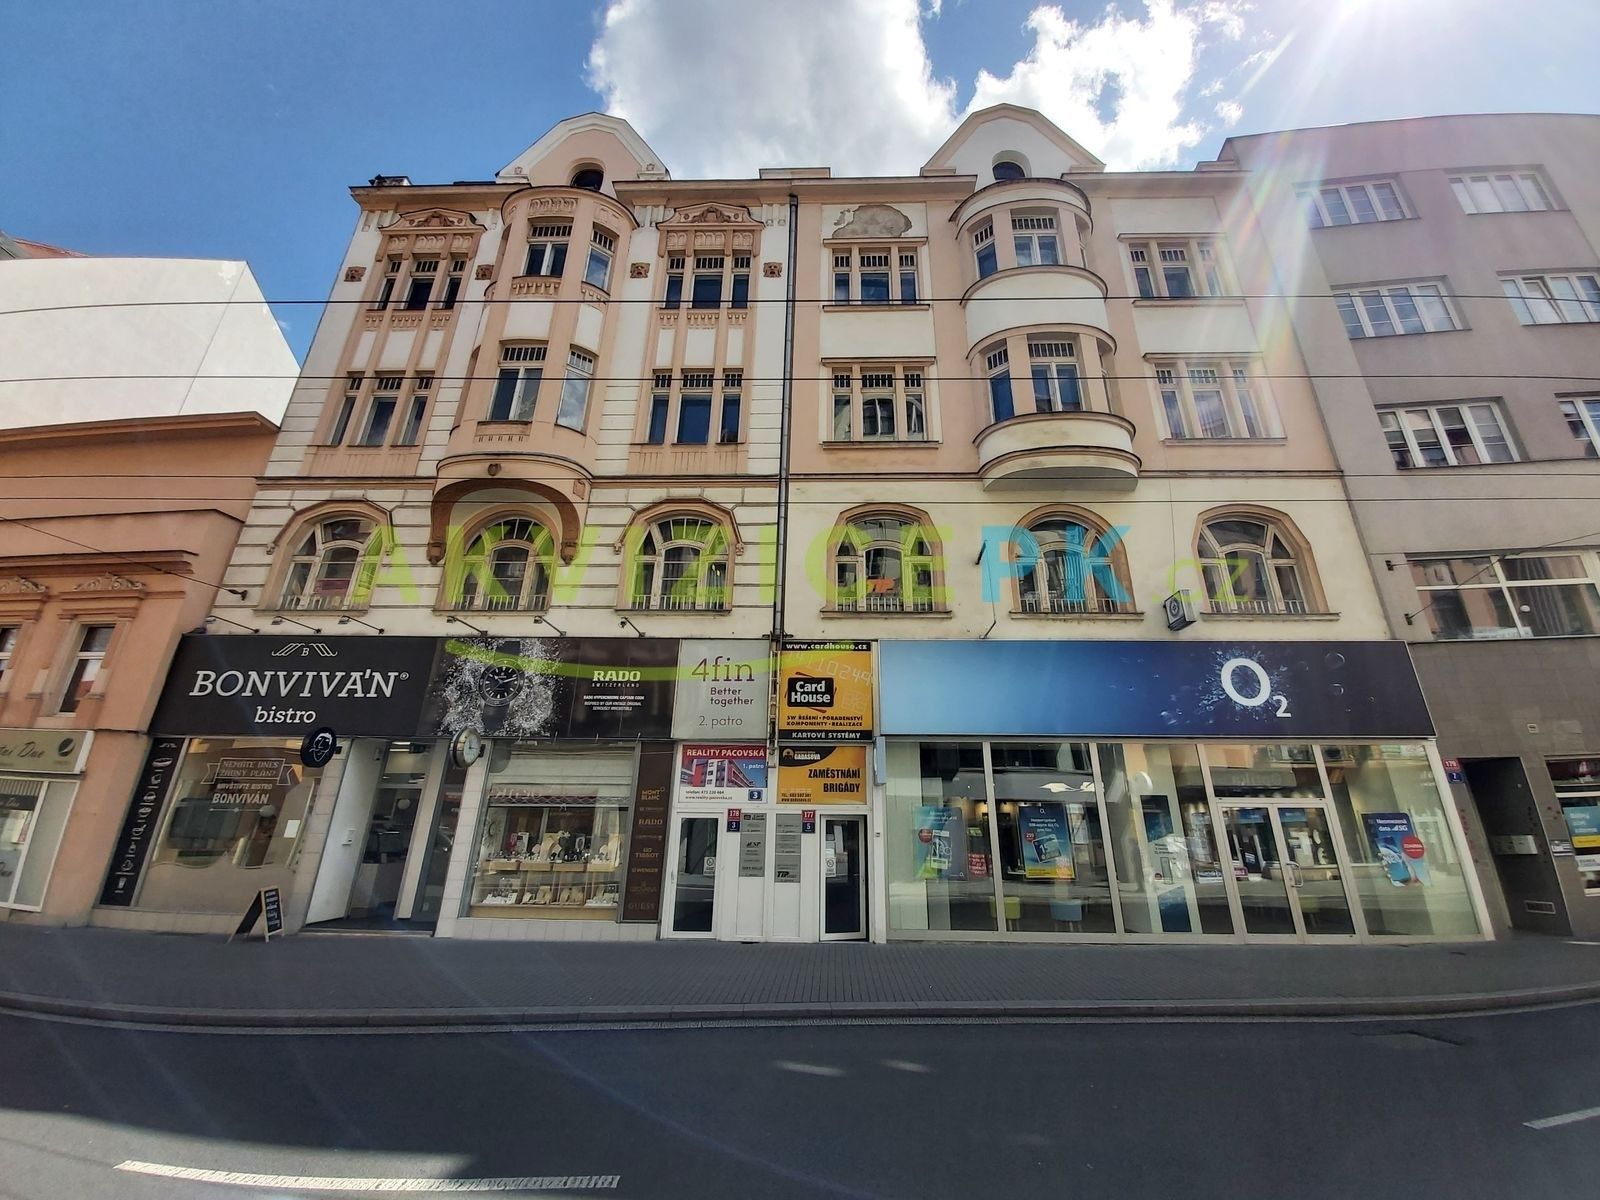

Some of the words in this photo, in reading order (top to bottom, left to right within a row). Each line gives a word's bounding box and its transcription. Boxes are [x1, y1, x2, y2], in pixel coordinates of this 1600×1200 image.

[691, 656, 754, 681] 4fin
[593, 670, 641, 682] RADO
[711, 687, 742, 695] Better
[796, 681, 826, 692] Card
[711, 697, 754, 707] together
[791, 692, 831, 703] House
[254, 706, 317, 723] bistro
[699, 715, 708, 726] 2.
[711, 716, 743, 728] patro
[792, 731, 825, 739] KARTOVÉ
[828, 731, 861, 739] SYSTÉMY
[687, 749, 720, 757] REALITY
[722, 748, 765, 757] PACOVSKÁ
[808, 768, 861, 779] ZAMĚSTNÁNÍ
[823, 782, 861, 793] BRIGÁDY
[212, 791, 270, 805] BONVIVÁN
